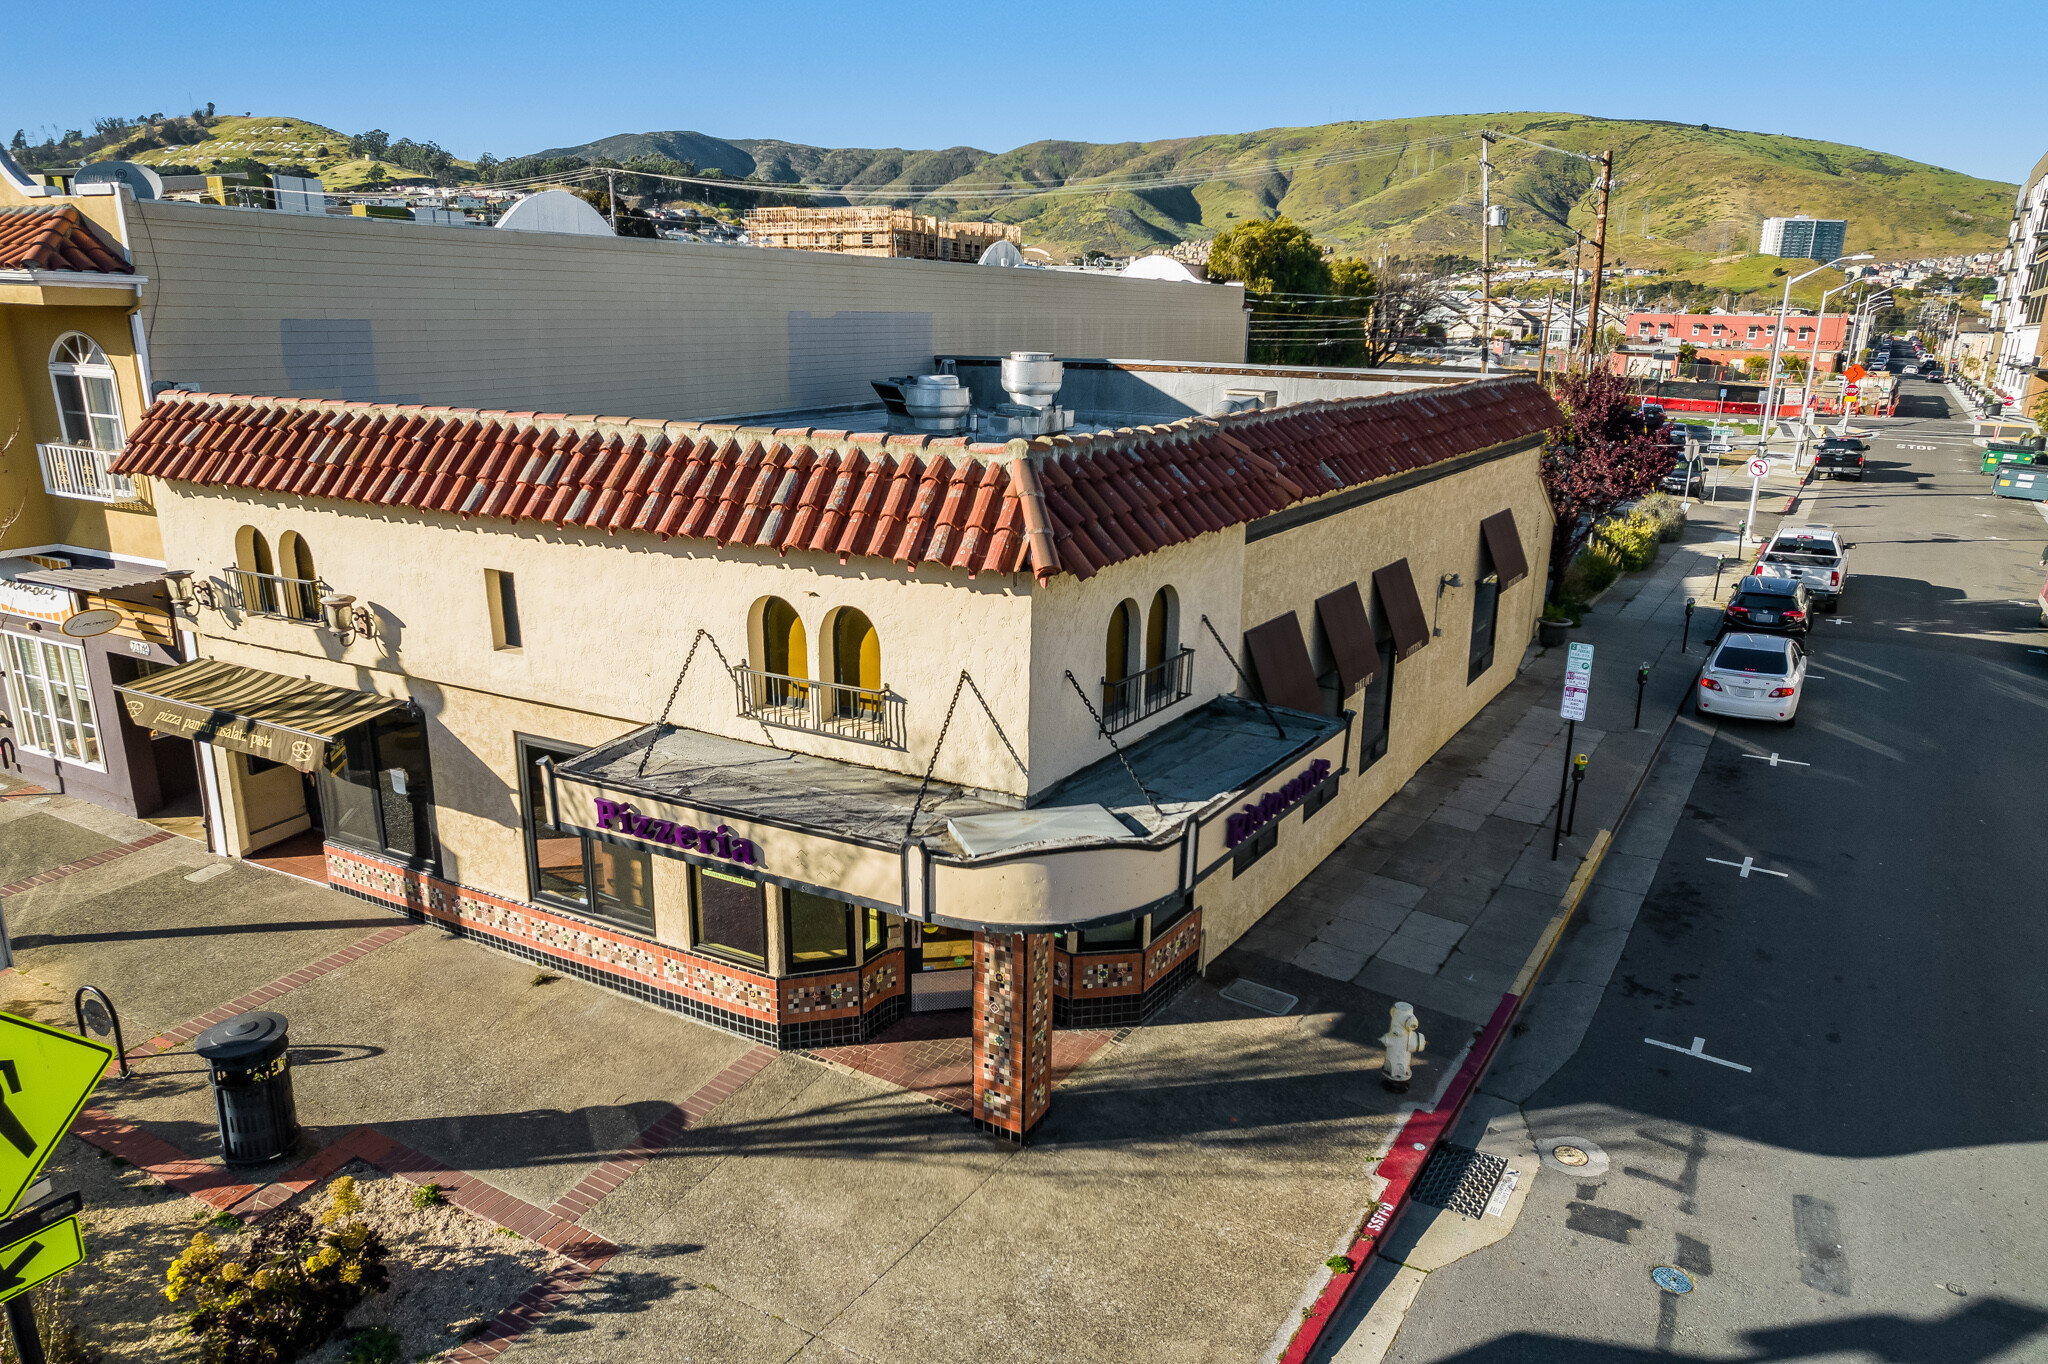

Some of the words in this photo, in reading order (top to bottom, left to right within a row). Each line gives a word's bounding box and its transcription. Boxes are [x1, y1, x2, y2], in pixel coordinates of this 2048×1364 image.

[1895, 443, 1937, 451] STOP
[154, 710, 182, 724] pizza
[181, 717, 213, 733] panini
[214, 722, 248, 742] insalata
[249, 734, 273, 749] pasta
[594, 797, 757, 865] Pizzeria
